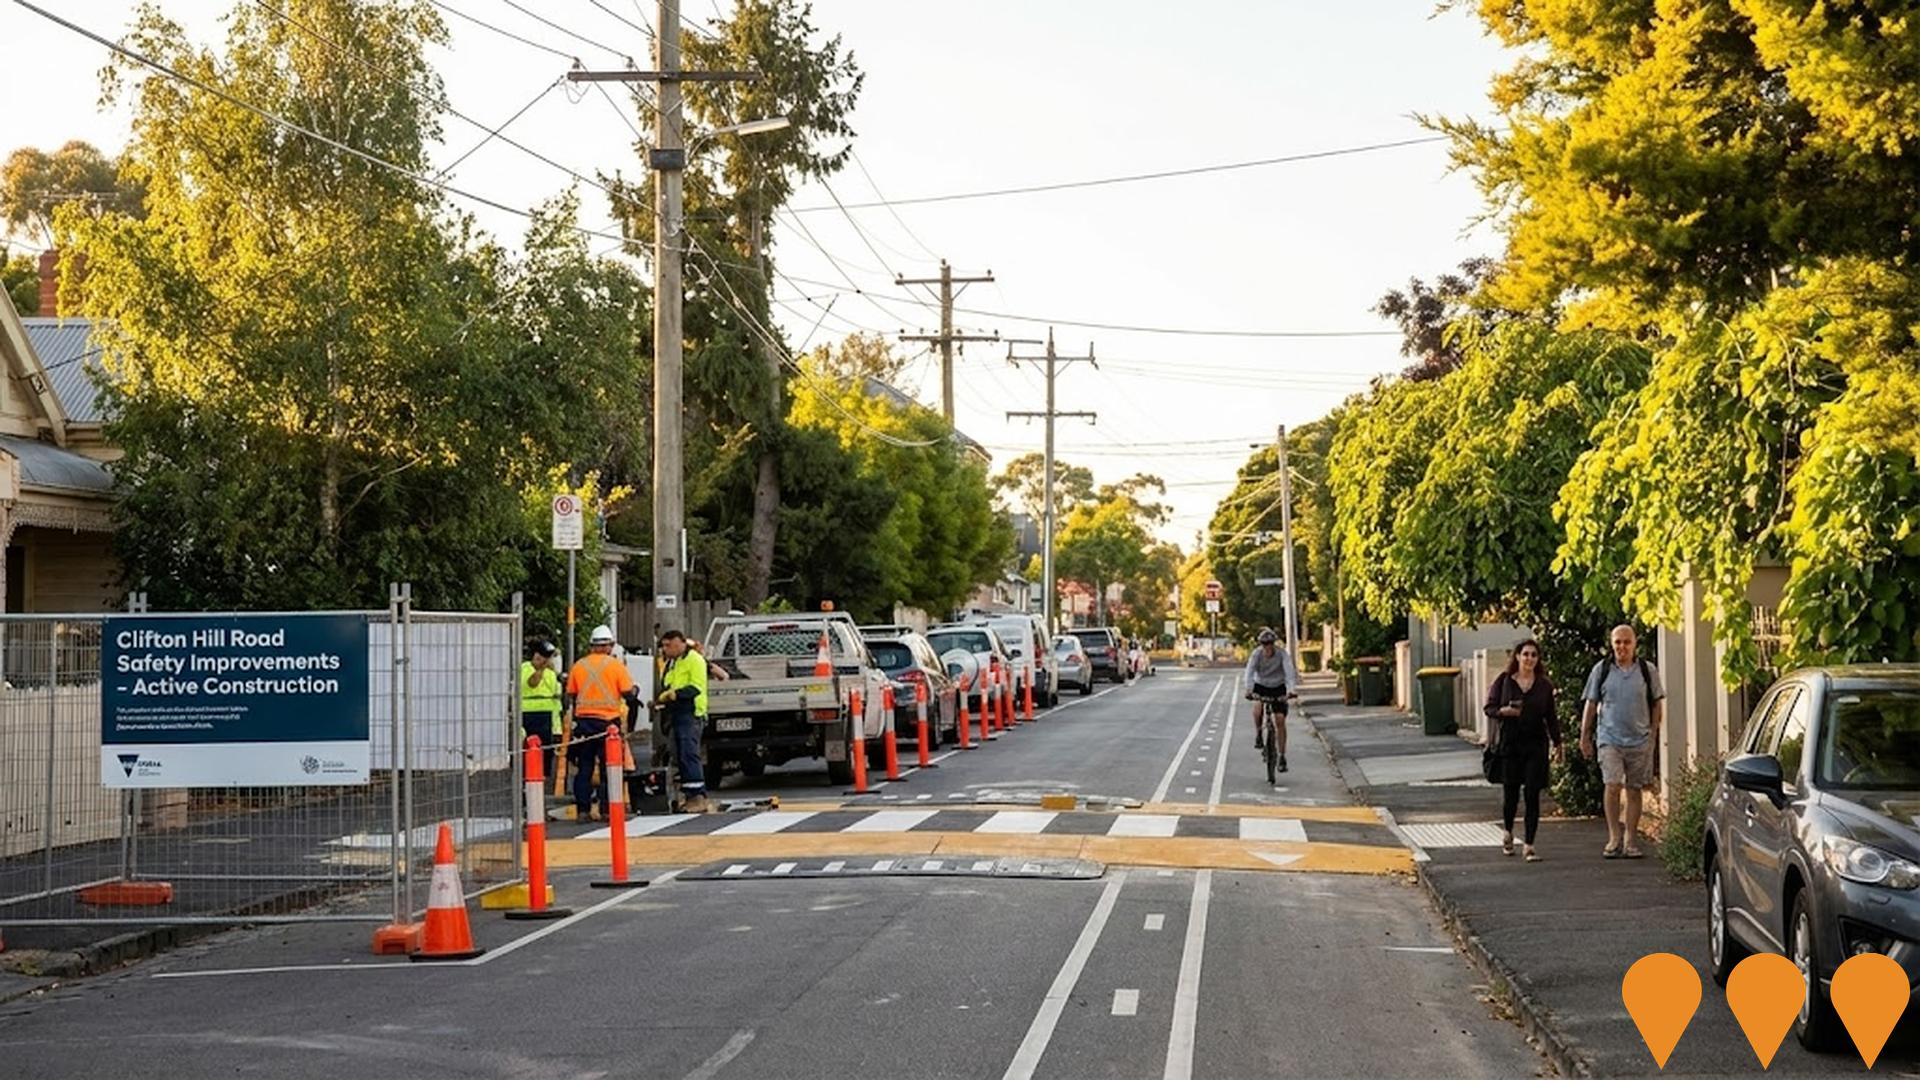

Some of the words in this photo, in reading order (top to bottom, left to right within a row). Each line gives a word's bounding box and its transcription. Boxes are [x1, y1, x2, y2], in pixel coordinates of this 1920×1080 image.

[116, 630, 187, 648] Clifton
[192, 629, 225, 647] Hill
[230, 629, 285, 647] Road
[116, 654, 185, 675] Safety
[190, 653, 340, 674] Improvements
[132, 677, 199, 695] Active
[202, 676, 339, 694] Construction
